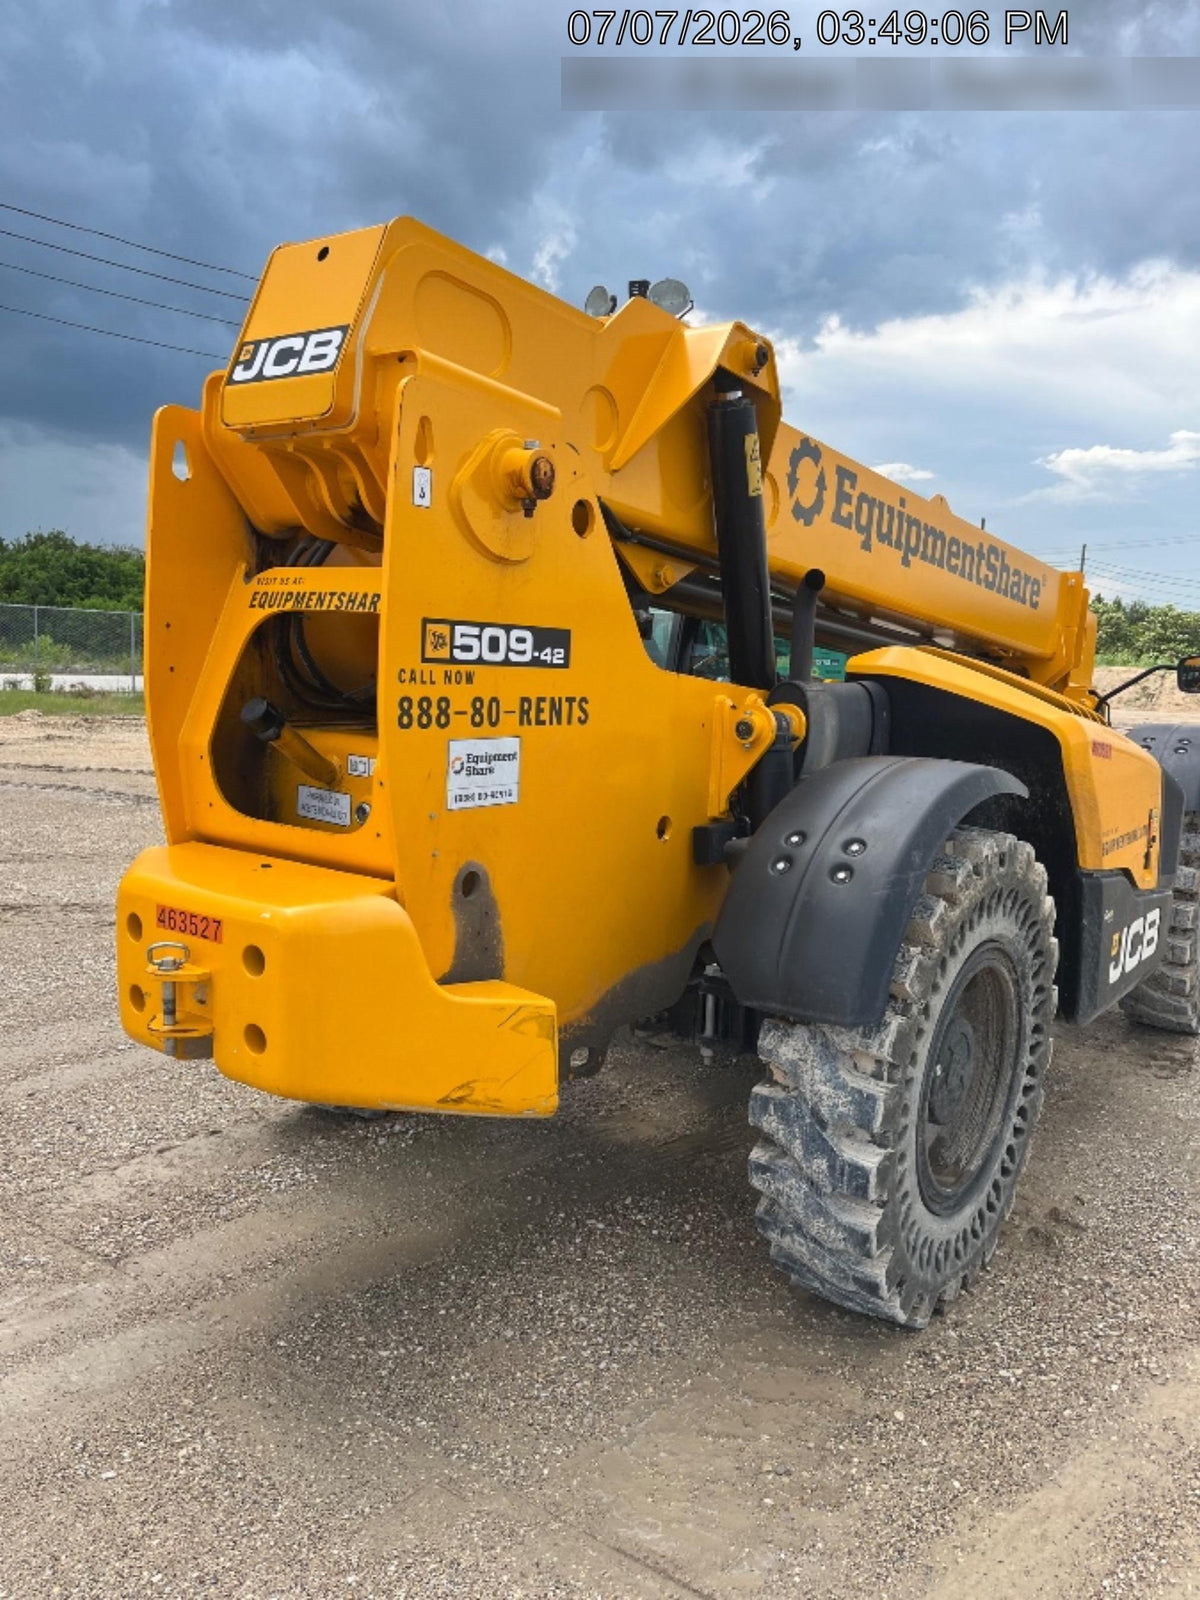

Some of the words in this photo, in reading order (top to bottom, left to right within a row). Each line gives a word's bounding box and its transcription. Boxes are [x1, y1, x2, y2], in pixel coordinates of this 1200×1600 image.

[232, 330, 343, 381] JCB
[831, 464, 1041, 610] EquipmentShare
[248, 591, 381, 612] EQUIPMENTSHAR
[398, 668, 436, 685] CALL
[443, 670, 476, 686] NOW
[397, 696, 590, 729] 888-80-RENTS
[465, 766, 495, 777] Share
[466, 752, 518, 765] Equipment
[157, 908, 221, 942] 463527
[1109, 907, 1160, 984] JCB
